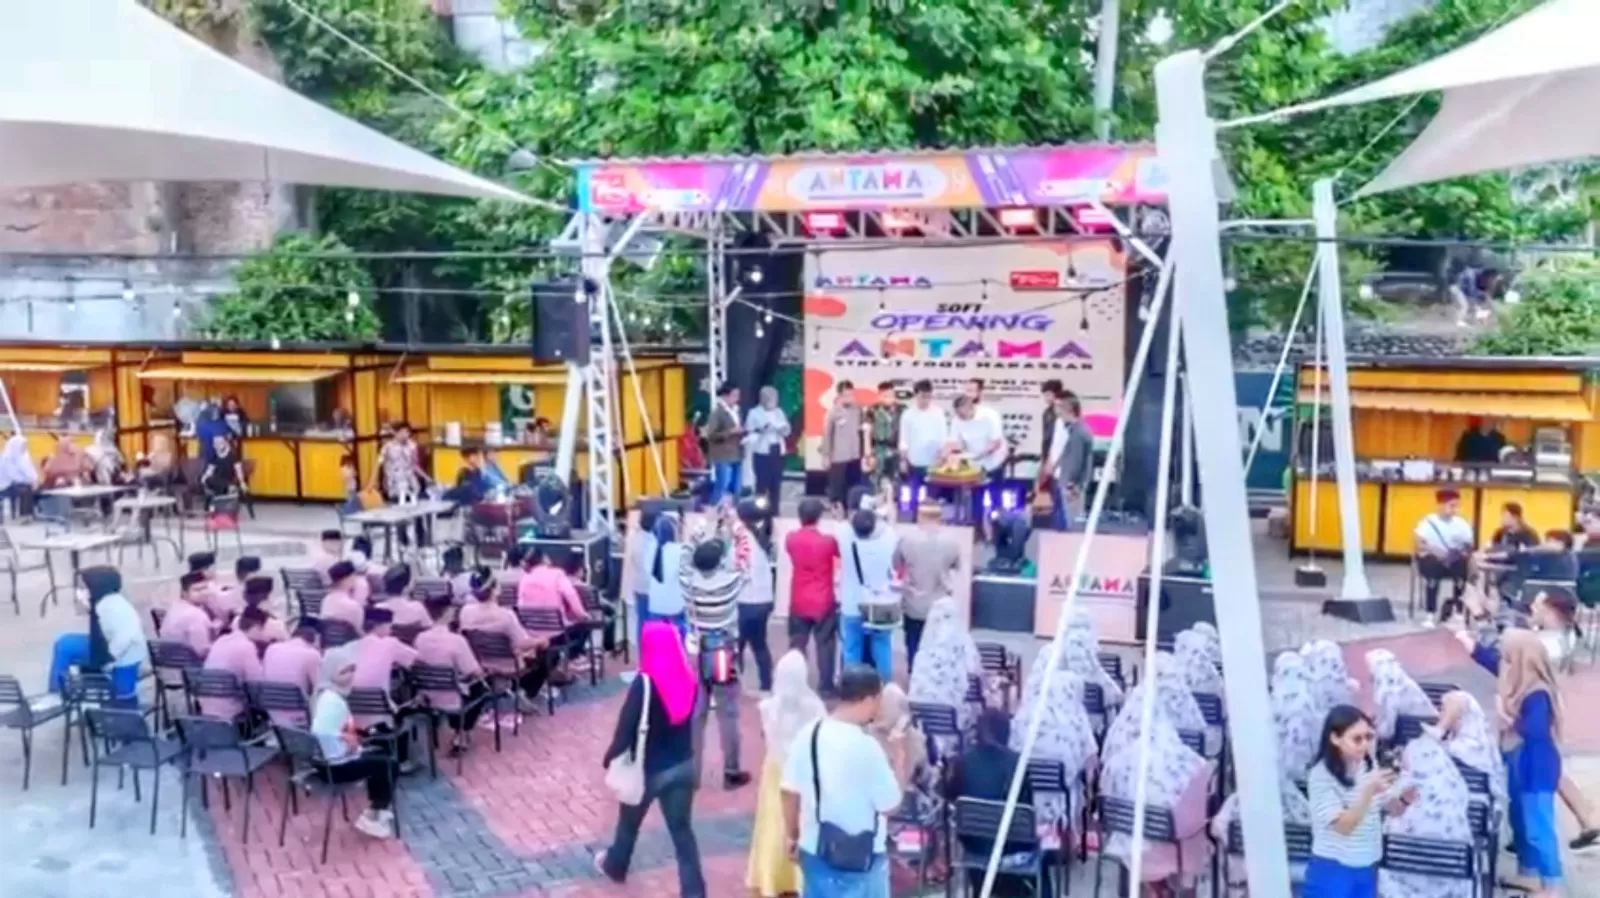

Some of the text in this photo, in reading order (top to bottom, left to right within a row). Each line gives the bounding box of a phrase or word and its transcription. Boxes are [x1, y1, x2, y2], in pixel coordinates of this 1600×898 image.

[809, 168, 923, 192] ANTAMA
[936, 302, 982, 314] SOFT
[870, 313, 1055, 332] OPENING
[836, 339, 1093, 359] ANTAMA
[912, 360, 967, 370] FOOD
[976, 361, 1093, 371] MAKASSAR
